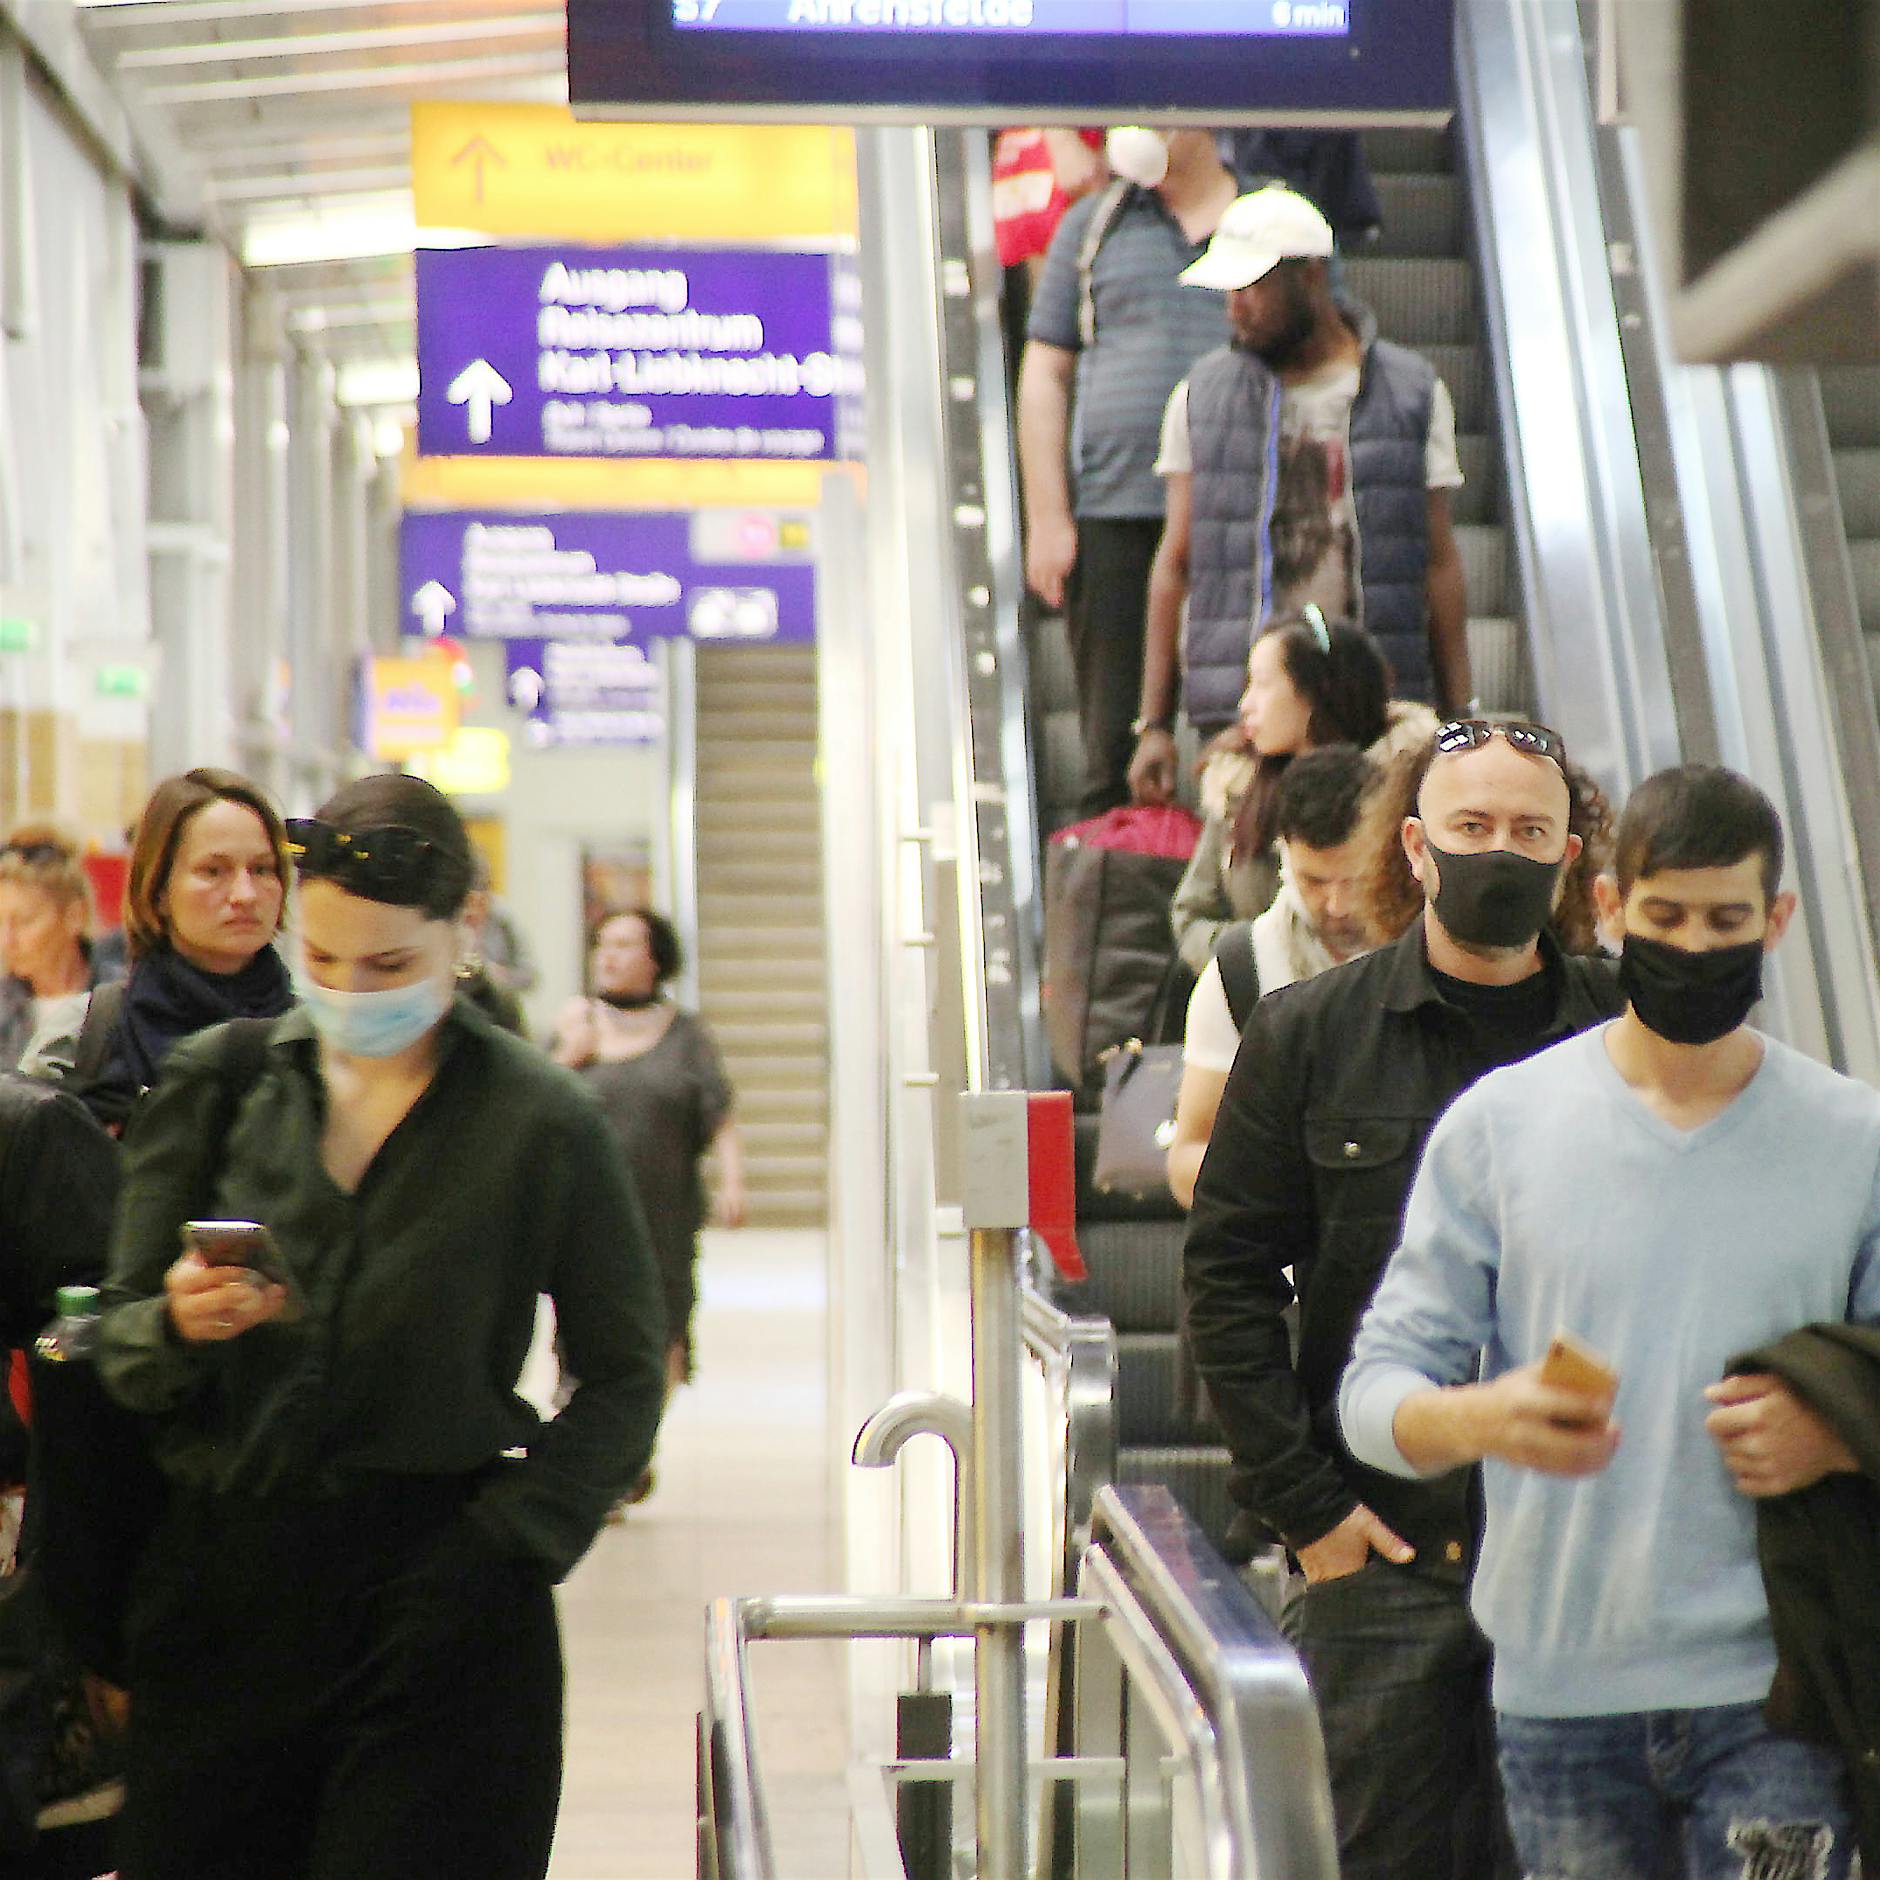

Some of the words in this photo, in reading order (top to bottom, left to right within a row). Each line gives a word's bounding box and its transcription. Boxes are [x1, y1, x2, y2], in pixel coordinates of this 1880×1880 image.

[1292, 0, 1345, 28] min
[544, 142, 716, 175] WC-Center
[539, 262, 688, 313] Ausgang
